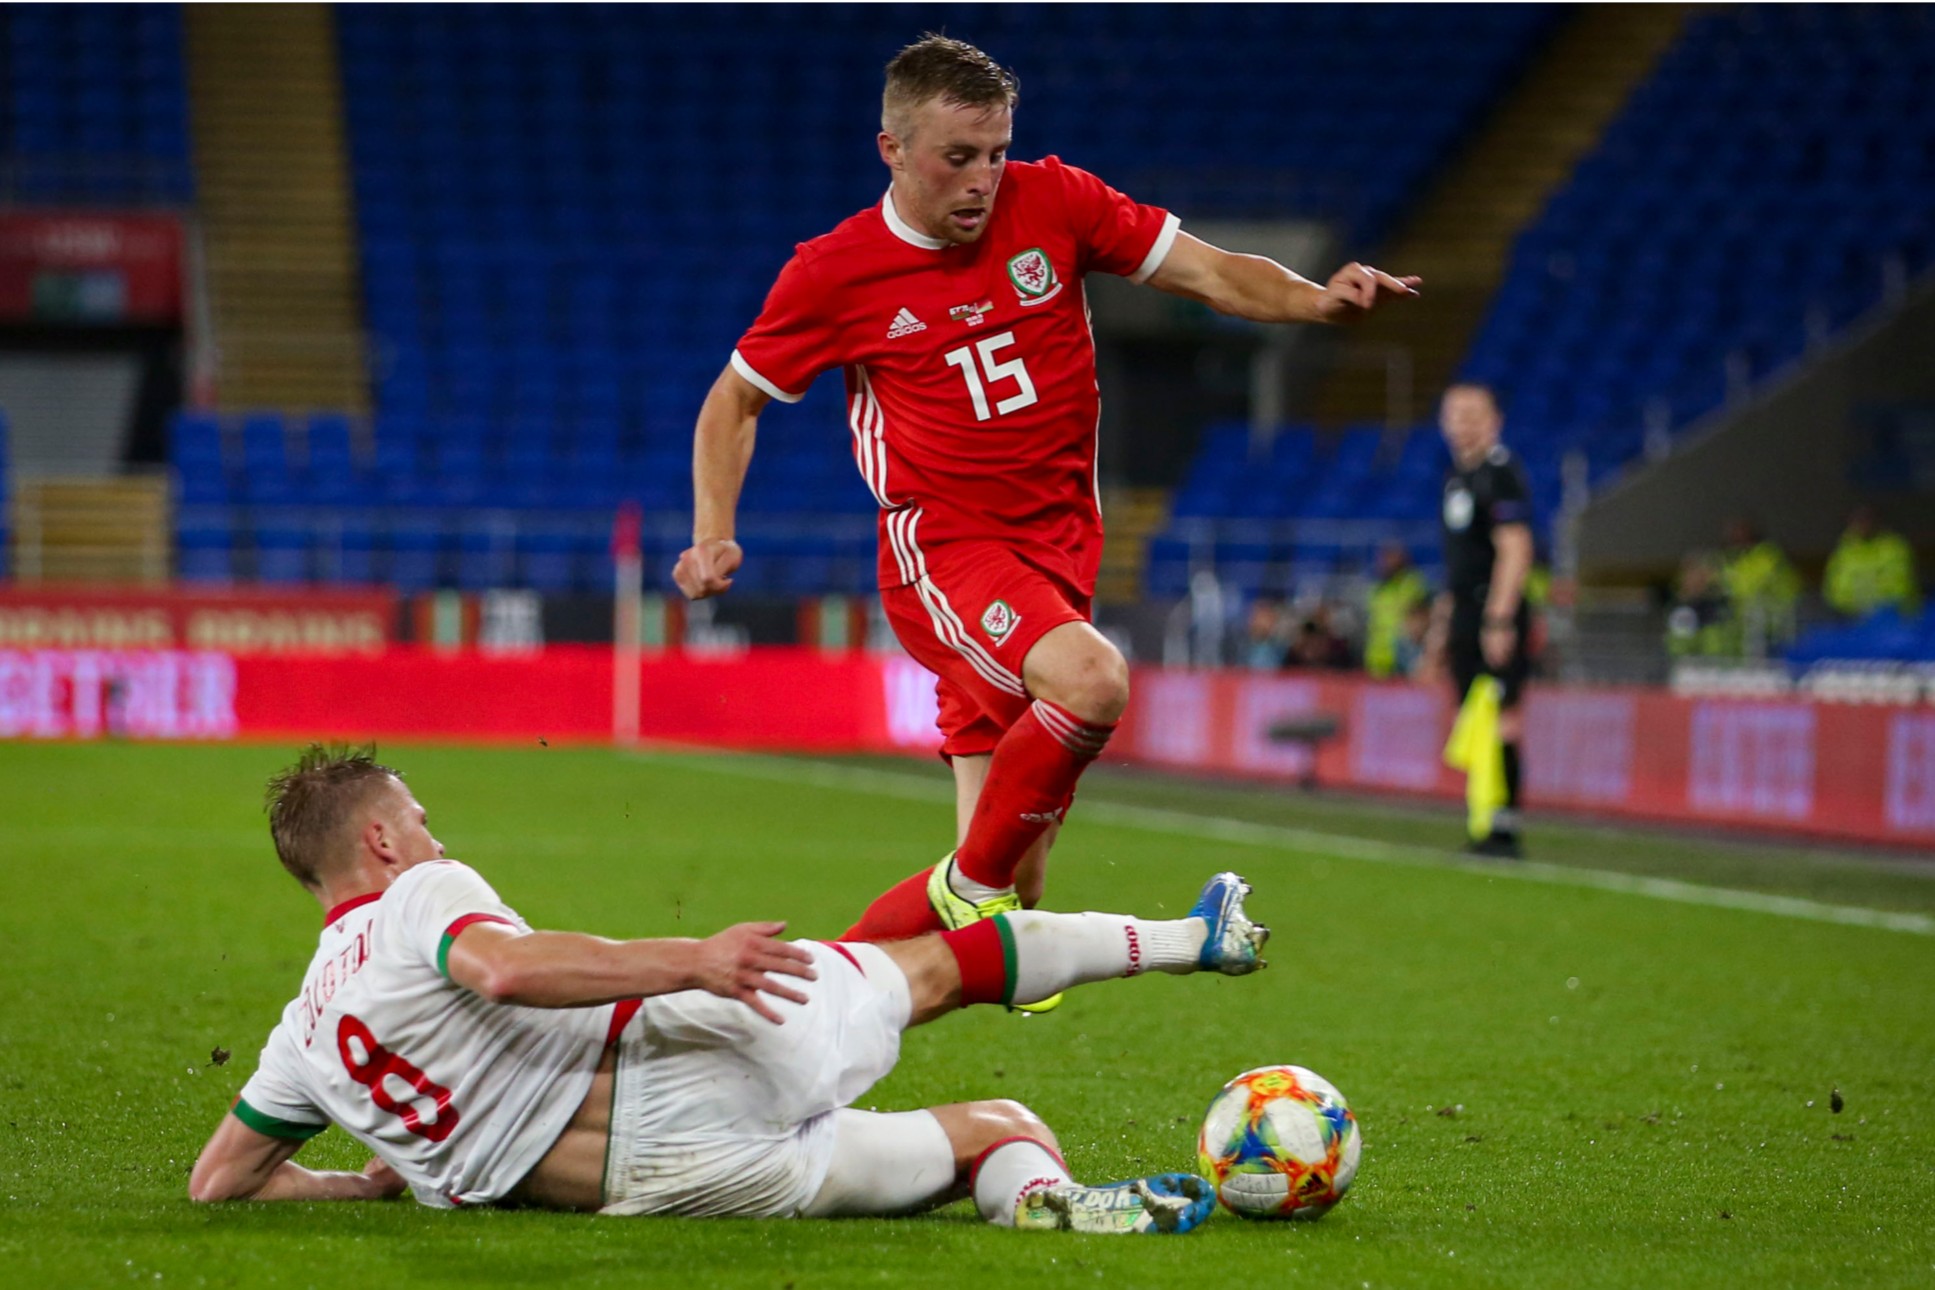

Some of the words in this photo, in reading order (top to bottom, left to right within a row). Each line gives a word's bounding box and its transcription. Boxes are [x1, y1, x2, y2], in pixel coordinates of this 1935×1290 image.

[886, 321, 928, 339] adidas
[944, 331, 1038, 421] 15
[337, 1014, 460, 1143] 8
